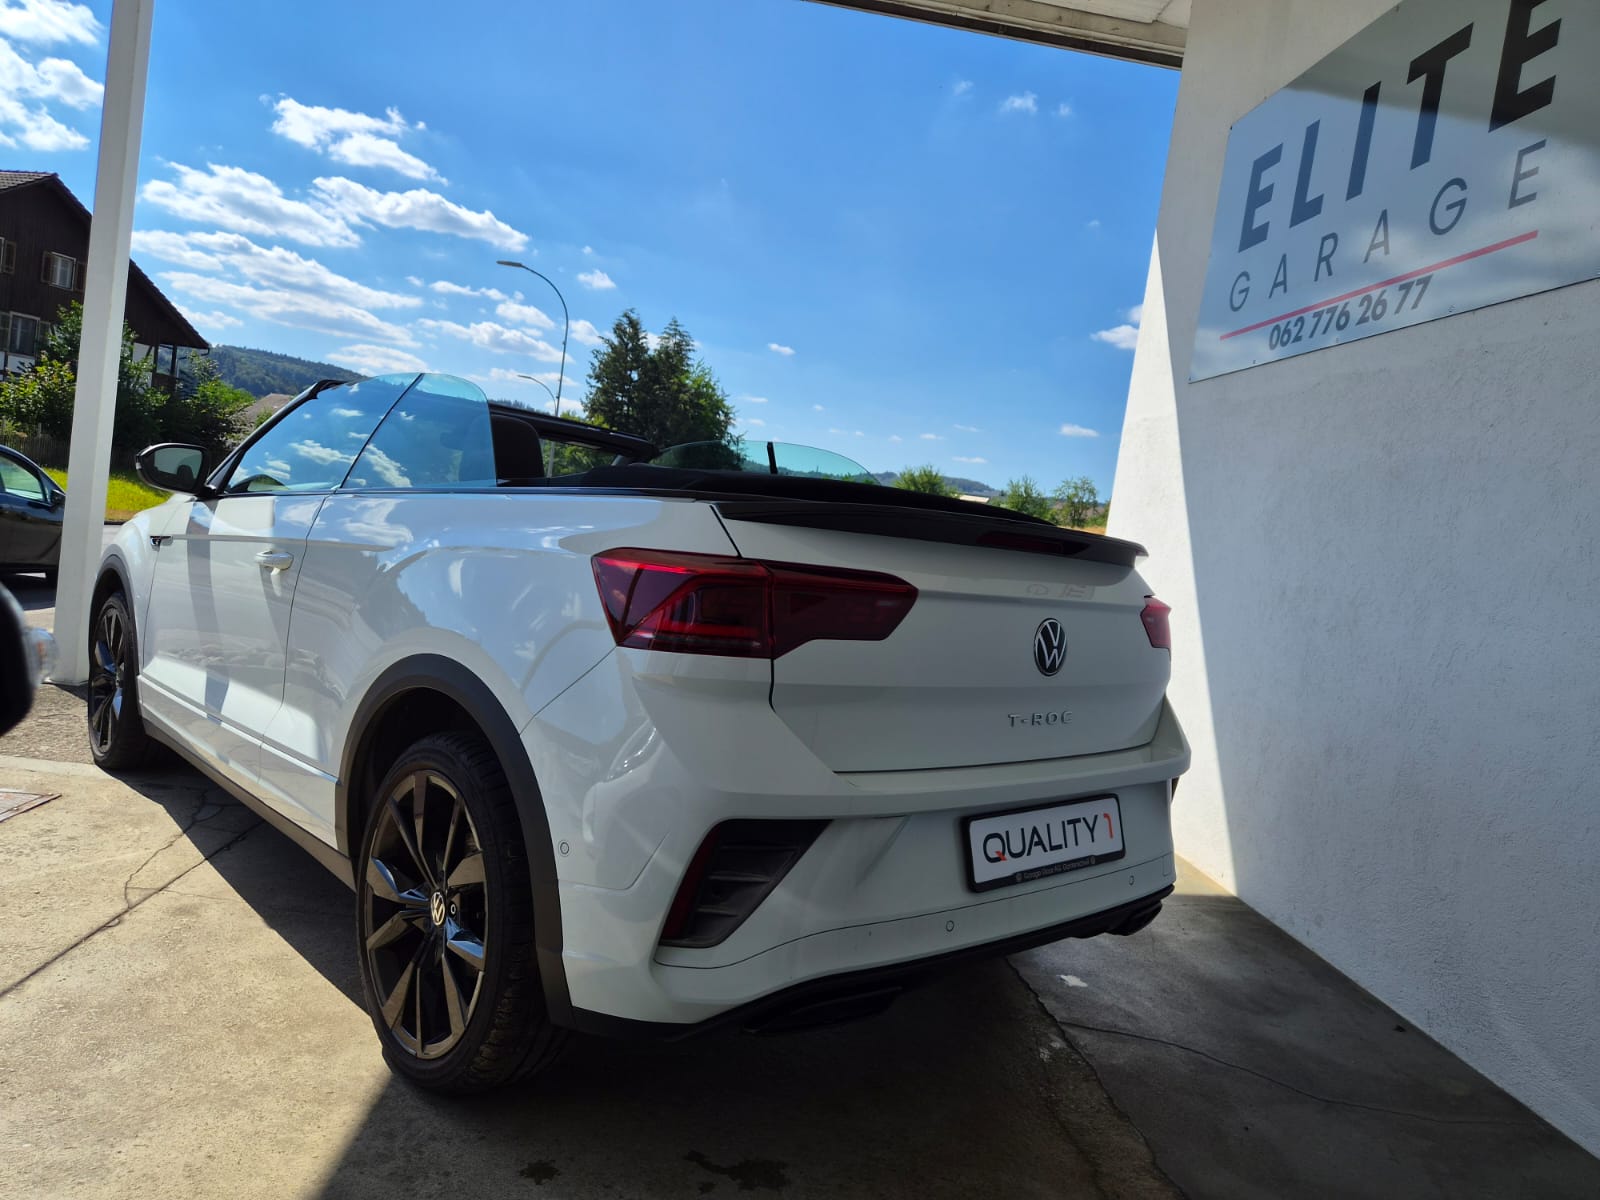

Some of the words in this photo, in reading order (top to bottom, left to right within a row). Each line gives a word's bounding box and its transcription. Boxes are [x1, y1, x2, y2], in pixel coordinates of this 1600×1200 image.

[1238, 0, 1562, 253] ELITE
[1229, 139, 1547, 313] GARAGE
[1268, 320, 1303, 351] 062
[1308, 305, 1351, 339] 776
[1356, 291, 1388, 326] 26
[1394, 274, 1434, 315] 77
[1007, 710, 1073, 728] T-ROC
